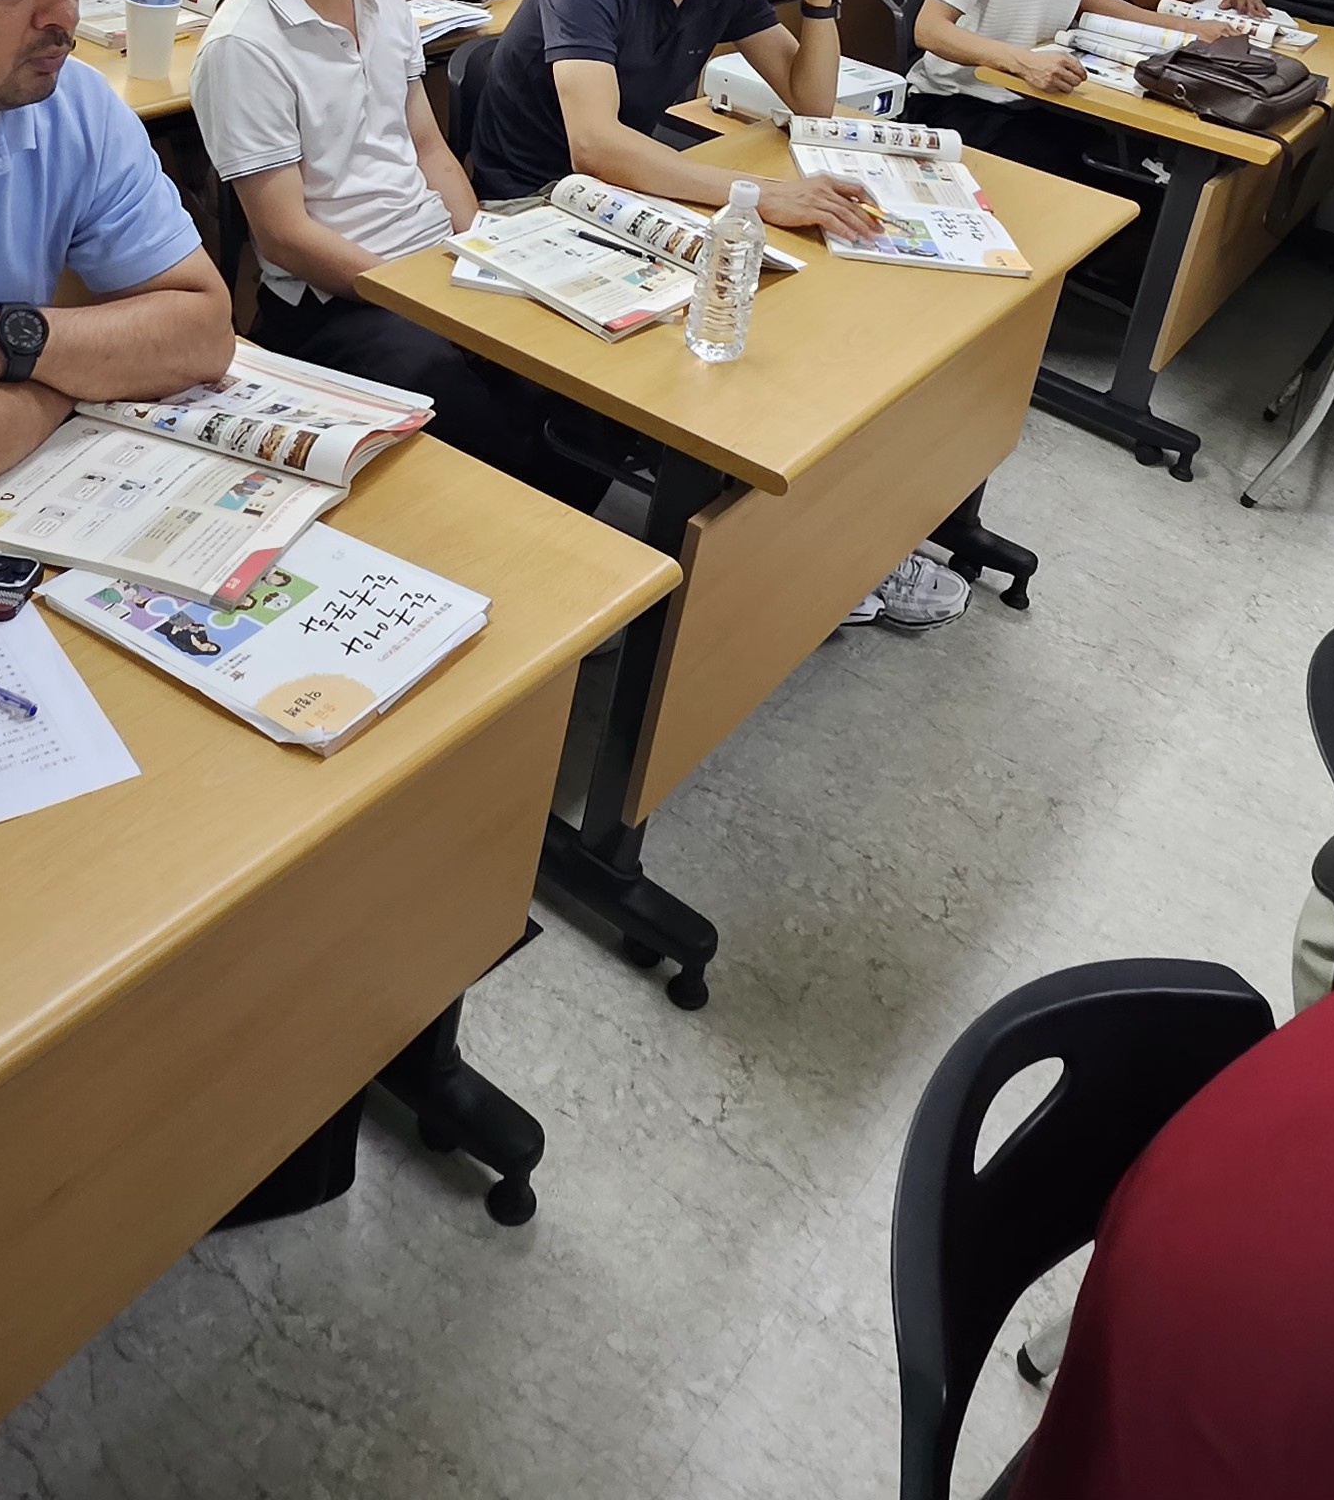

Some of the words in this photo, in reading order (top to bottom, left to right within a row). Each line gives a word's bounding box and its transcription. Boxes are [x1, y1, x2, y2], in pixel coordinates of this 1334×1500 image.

[299, 574, 399, 634] 한국문화
[341, 592, 438, 656] 한국어와
[283, 690, 322, 718] 익힘책
